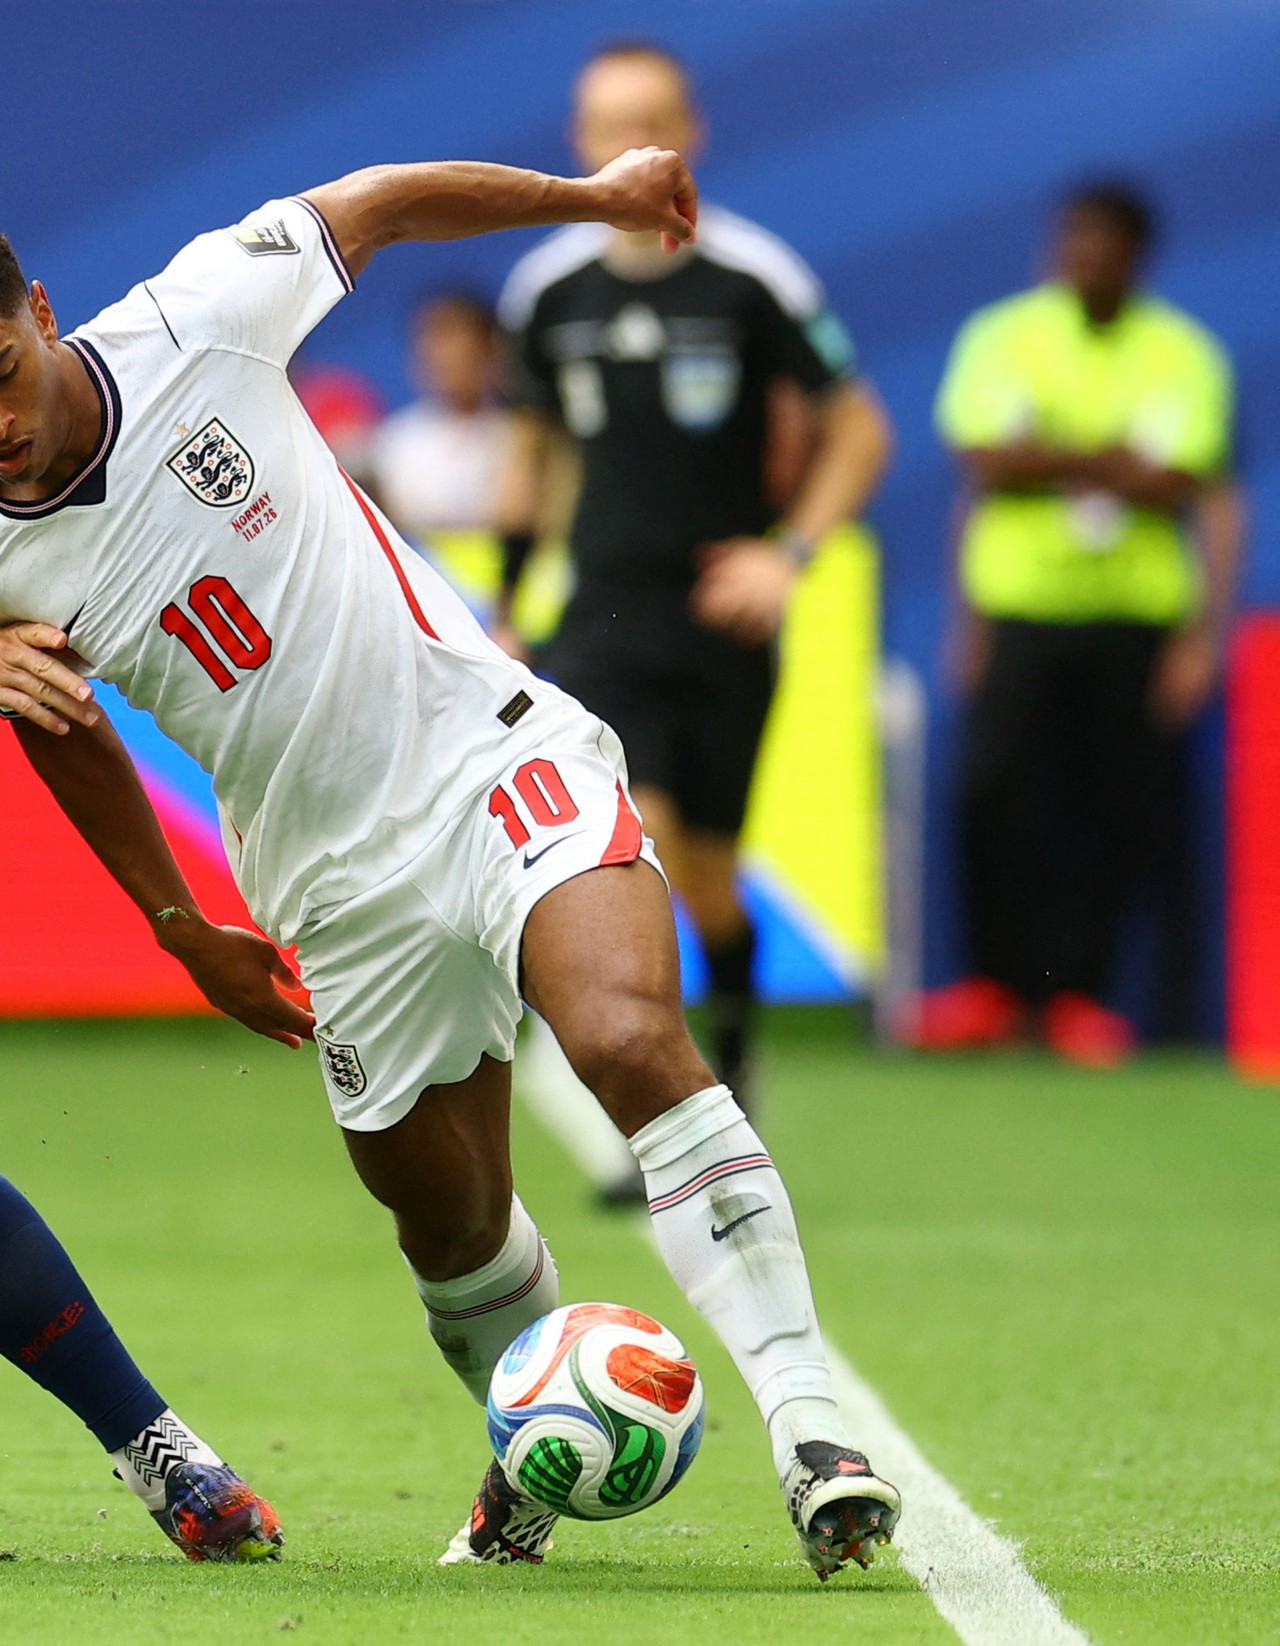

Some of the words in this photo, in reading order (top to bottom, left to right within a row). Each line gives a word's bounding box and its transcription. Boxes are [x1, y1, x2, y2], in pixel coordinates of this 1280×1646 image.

[231, 491, 272, 533] NORWAY
[242, 508, 277, 542] 11.07.26
[160, 575, 272, 692] 10
[488, 758, 580, 851] 10
